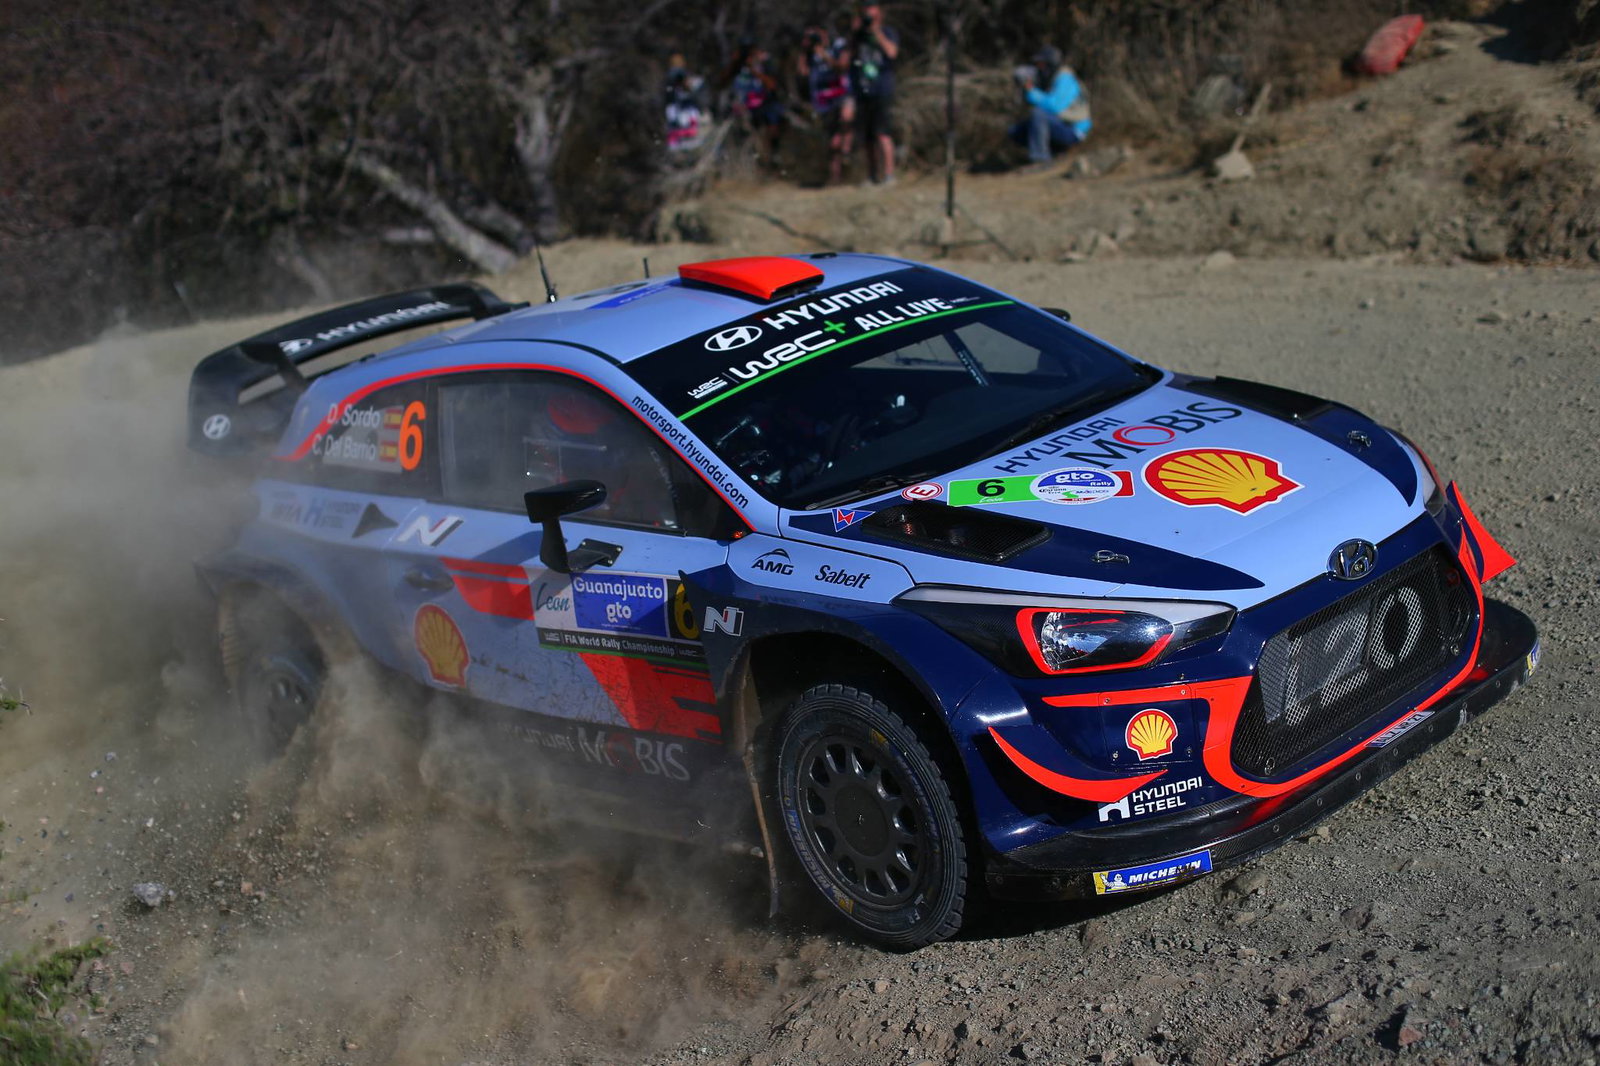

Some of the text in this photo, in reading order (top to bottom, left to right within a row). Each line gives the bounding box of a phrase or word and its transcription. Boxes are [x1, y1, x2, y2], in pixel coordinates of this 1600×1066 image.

[762, 281, 904, 331] HYUNDAI
[854, 311, 902, 332] ALL
[896, 297, 953, 318] LIVE
[341, 404, 381, 429] Sordo
[400, 399, 427, 472] 6
[993, 416, 1127, 474] HYUNDAI
[1060, 401, 1242, 468] MOBIS
[631, 394, 749, 510] motorsport.hyundai.com
[976, 479, 1006, 497] 6
[1055, 472, 1095, 484] gto
[751, 557, 795, 577] AMG
[814, 564, 872, 590] Sabelt
[573, 576, 664, 601] Guanajuato
[606, 601, 632, 623] gto
[674, 583, 701, 640] 6
[564, 632, 579, 645] FIA
[578, 633, 601, 648] World
[601, 637, 621, 650] Rally
[577, 726, 692, 782] MOBIS
[1132, 776, 1203, 803] HYUNDAI
[1133, 795, 1187, 816] STEEL
[1127, 859, 1202, 884] MICHELIN
